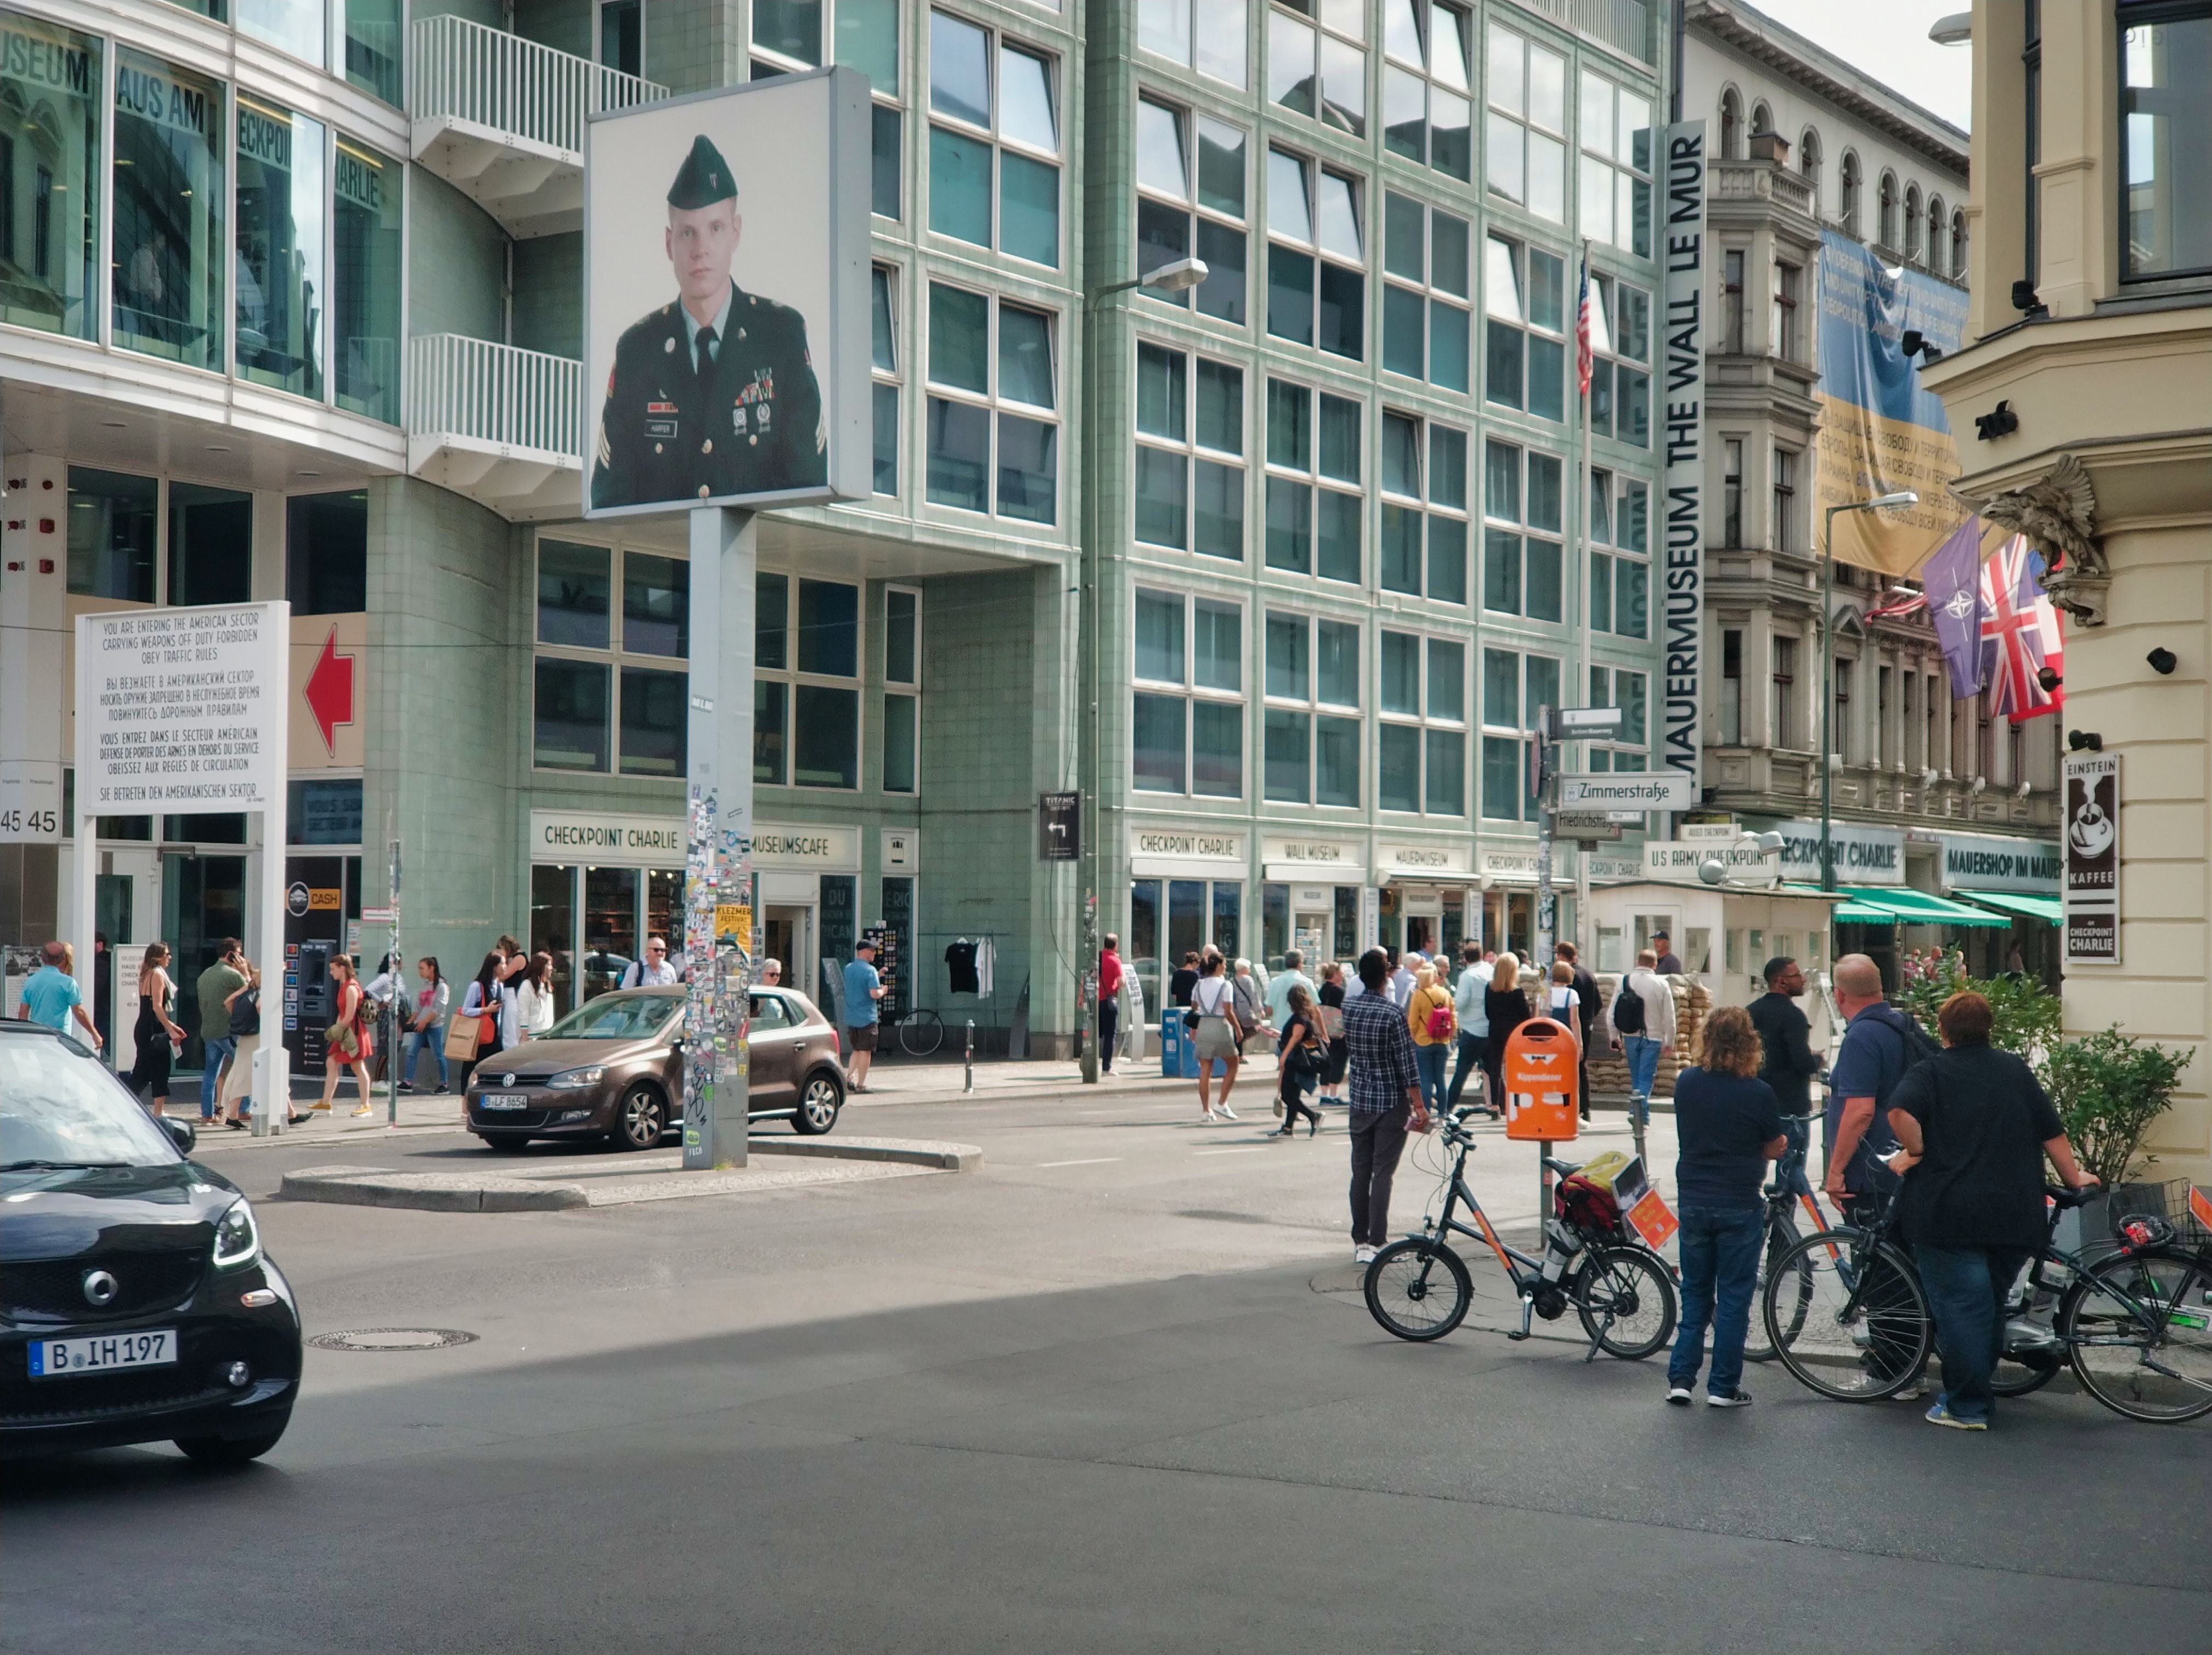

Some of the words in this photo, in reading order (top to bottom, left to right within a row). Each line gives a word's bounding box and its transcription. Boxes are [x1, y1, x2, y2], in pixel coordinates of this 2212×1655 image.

[168, 83, 204, 133] AM
[1669, 135, 1702, 223] MUR
[1669, 234, 1700, 272] LE
[1668, 289, 1700, 392] WALL
[1667, 401, 1699, 468] THE
[104, 622, 117, 635] YOU
[121, 621, 134, 634] ARE
[138, 618, 171, 633] ENTERING
[174, 617, 185, 631] THE
[189, 615, 227, 629] AMERICAN
[230, 612, 258, 627] SECTOR
[103, 637, 138, 650] CARRYING
[141, 634, 176, 649] WEAPONS
[178, 633, 191, 646] OFF
[195, 632, 214, 645] DUTY
[217, 629, 258, 643] FORBIDDEN
[142, 651, 160, 664] OBEY
[163, 649, 192, 663] TRAFFIC
[195, 648, 218, 661] RULES
[159, 675, 163, 688] В
[227, 669, 254, 684] СЕКТОР
[186, 689, 191, 702] В
[100, 733, 118, 745] VOUS
[122, 731, 146, 744] ENTREZ
[150, 730, 169, 743] DANS
[172, 730, 179, 742] LE
[182, 729, 213, 741] SECTEUR
[100, 747, 123, 760] DEFENSE
[125, 747, 133, 759] DE
[133, 746, 154, 759] PORTER
[155, 745, 166, 758] DES
[167, 744, 187, 757] ARMES
[188, 744, 196, 757] EN
[198, 743, 222, 756] DEHORS
[223, 742, 232, 755] DU
[234, 742, 259, 755] SERVICE
[108, 762, 142, 775] OBEISSEZ
[145, 761, 159, 773] AUX
[162, 759, 188, 773] REGLES
[191, 759, 199, 772] DE
[203, 758, 249, 772] CIRCULATION
[2068, 760, 2116, 775] EINSTEIN
[100, 787, 111, 801] SIE
[114, 786, 146, 801] BETRETEN
[149, 785, 163, 800] DEN
[166, 784, 226, 799] AMERIKANISCHEN
[229, 783, 257, 797] SEKTOR
[1580, 782, 1670, 802] Zimmerstraße
[1, 810, 20, 832] 45
[27, 810, 56, 832] 45
[545, 825, 623, 847] CHECKPOINT
[628, 830, 678, 849] CHARLIE
[1141, 835, 1195, 853] CHECKPOINT
[1198, 838, 1234, 856] CHARLIE
[1285, 844, 1306, 860] WALL
[1308, 845, 1340, 862] MUSEUM
[1396, 850, 1448, 866] MAUERMUSEUM
[1672, 850, 1702, 866] ARMY
[1848, 841, 1897, 868] CHARLIE
[1488, 855, 1526, 870] CHECKPOINT
[1618, 863, 1641, 877] CHARLIE
[1948, 848, 2013, 877] MAUERSHOP
[2016, 854, 2028, 878] IM
[2070, 871, 2113, 884] KAFFEE
[311, 893, 337, 904] CASH
[716, 907, 752, 916] KLEZMER
[2070, 927, 2113, 937] CHECKPOINT
[2070, 938, 2113, 951] CHARLIE
[1517, 1072, 1562, 1083] Kippendiener
[506, 1096, 526, 1106] 8654
[53, 1344, 68, 1369] B
